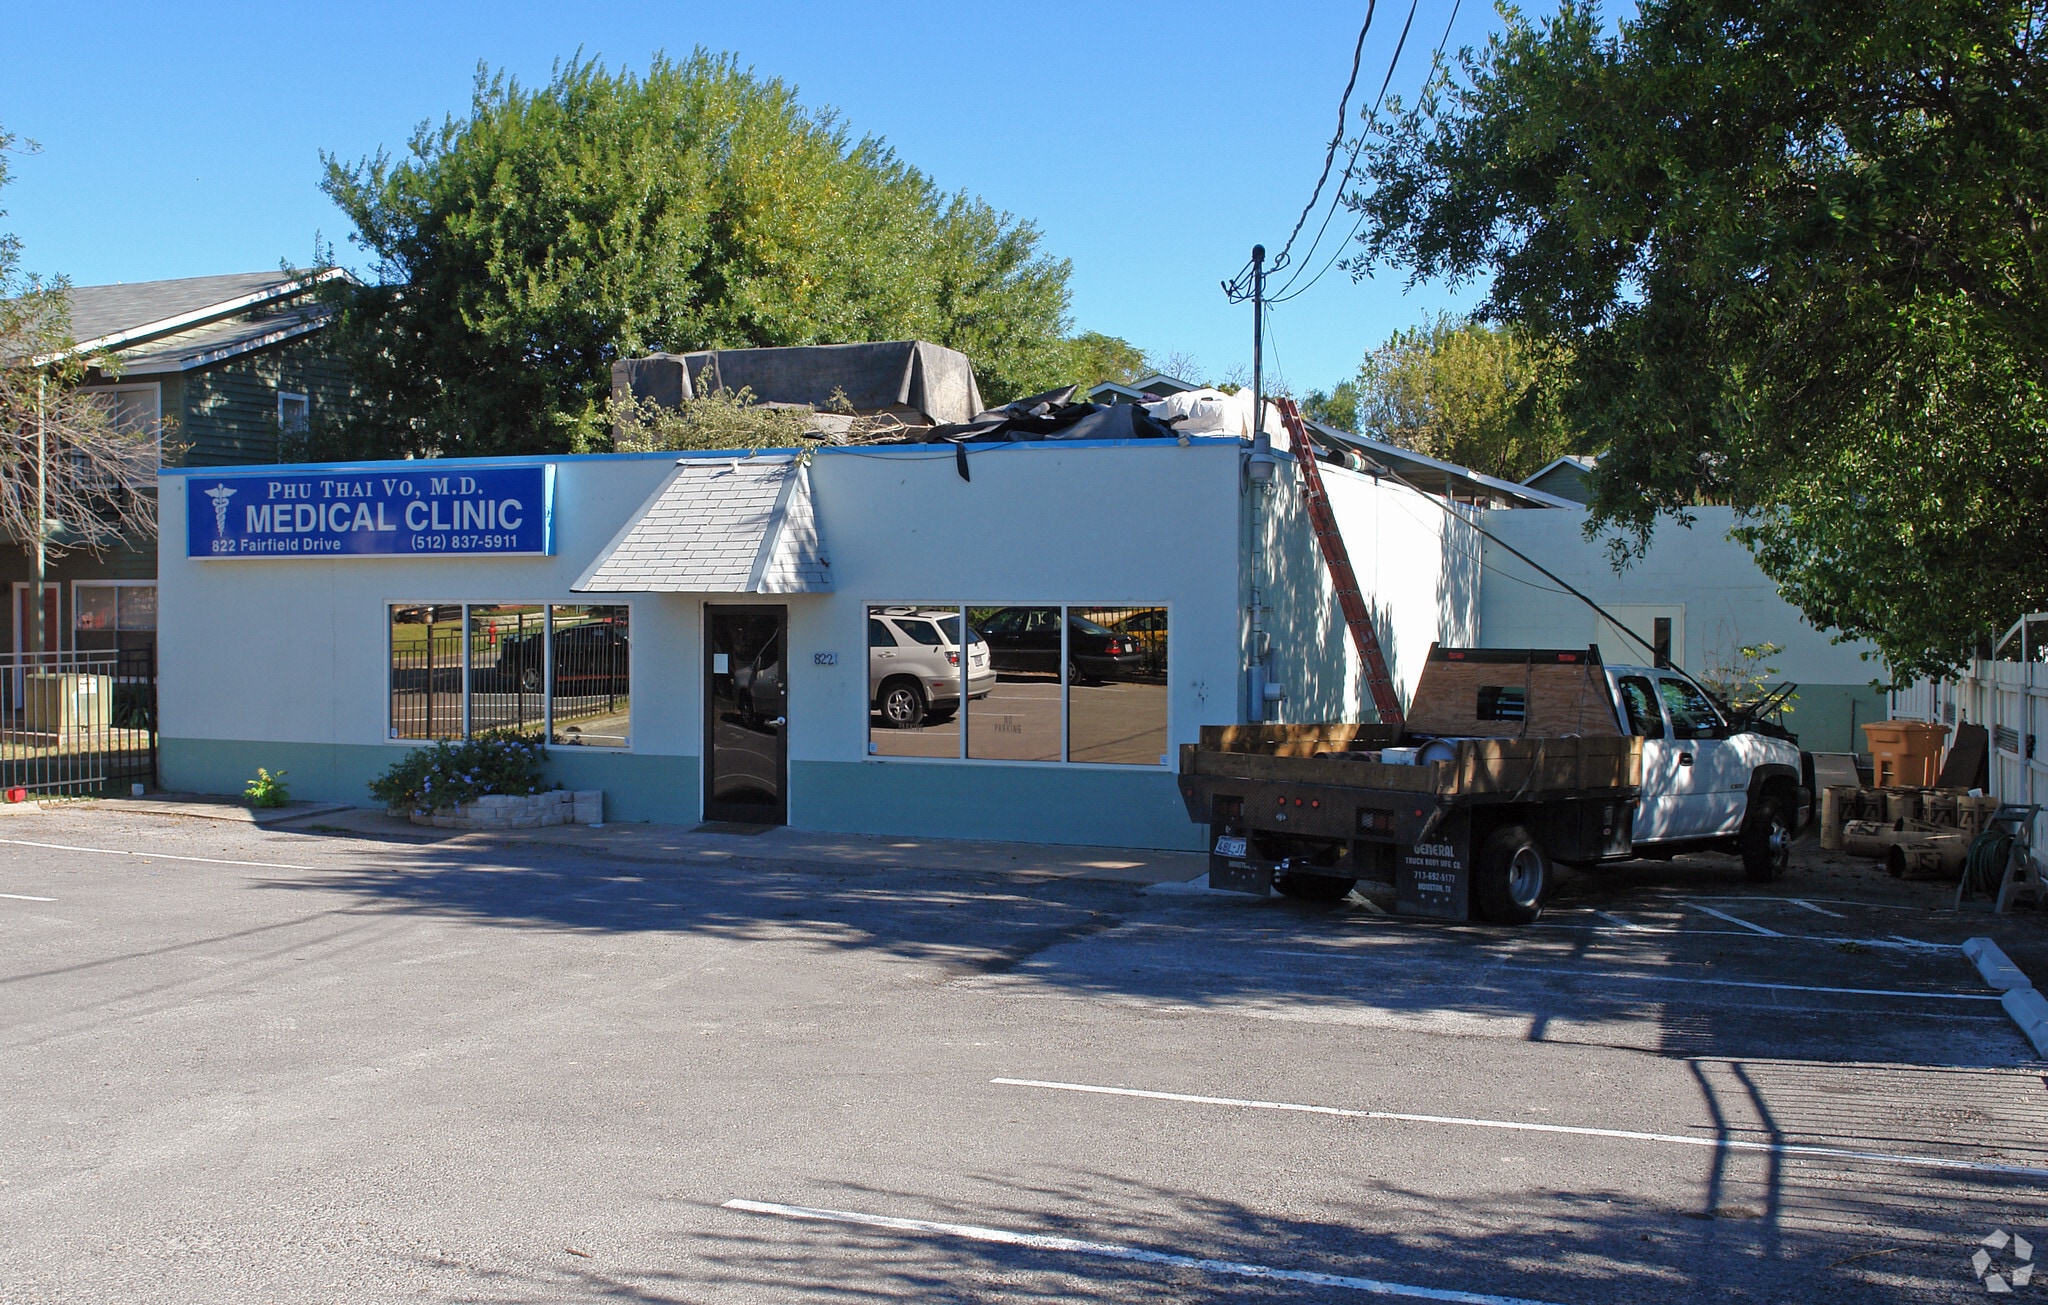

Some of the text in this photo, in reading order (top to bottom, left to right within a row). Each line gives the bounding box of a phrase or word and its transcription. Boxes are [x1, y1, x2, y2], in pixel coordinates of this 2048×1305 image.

[267, 476, 484, 500] PHU THAI VO, M.D.
[246, 498, 523, 534] MEDICAL CLINIC
[212, 537, 341, 552] 822 Fairfield Drive
[411, 533, 517, 551] (512) 837-5911
[814, 653, 834, 665] 822
[994, 723, 1022, 735] PARKING
[1413, 843, 1455, 858] GENERAL
[1405, 856, 1424, 865] TRUCK
